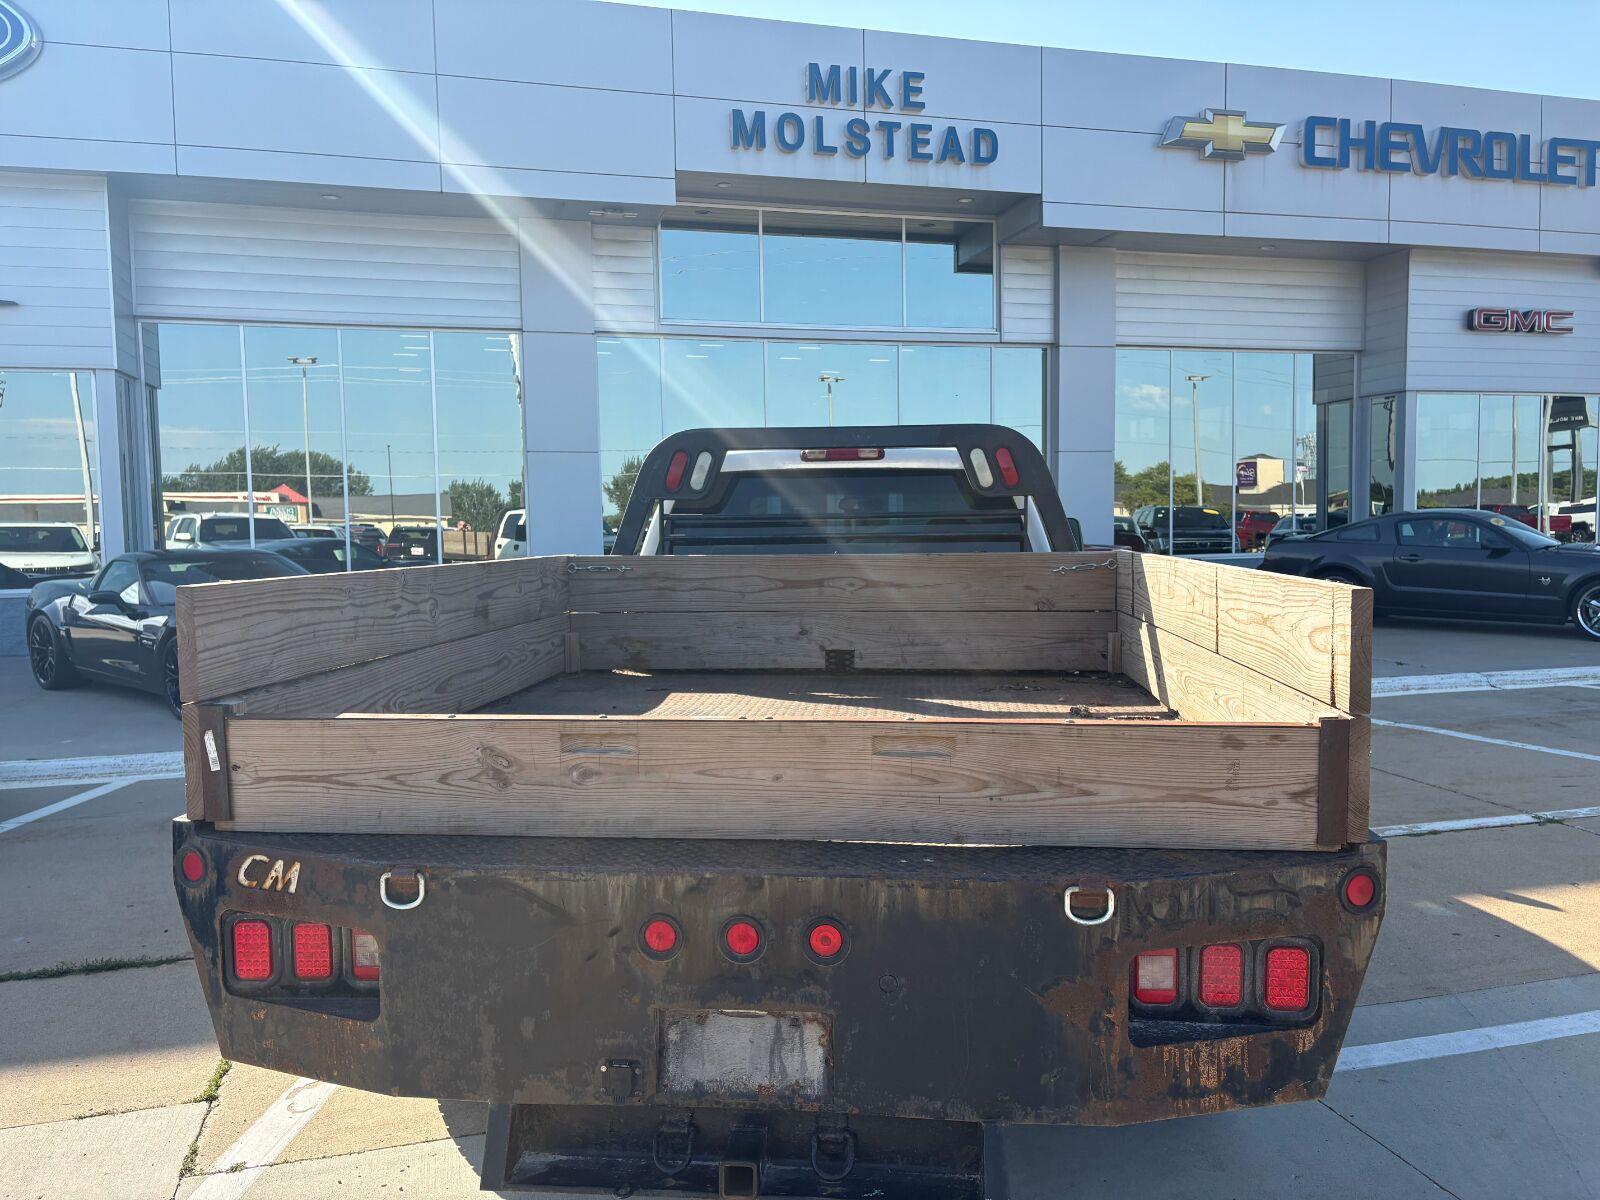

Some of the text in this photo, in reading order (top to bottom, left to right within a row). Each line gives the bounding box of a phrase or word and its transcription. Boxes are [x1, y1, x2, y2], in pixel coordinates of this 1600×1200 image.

[806, 62, 926, 111] MIKE
[731, 108, 999, 166] MOLSTEAD
[1302, 114, 1600, 188] CHEVROLET
[1473, 307, 1576, 334] GMC
[237, 854, 301, 894] CM
